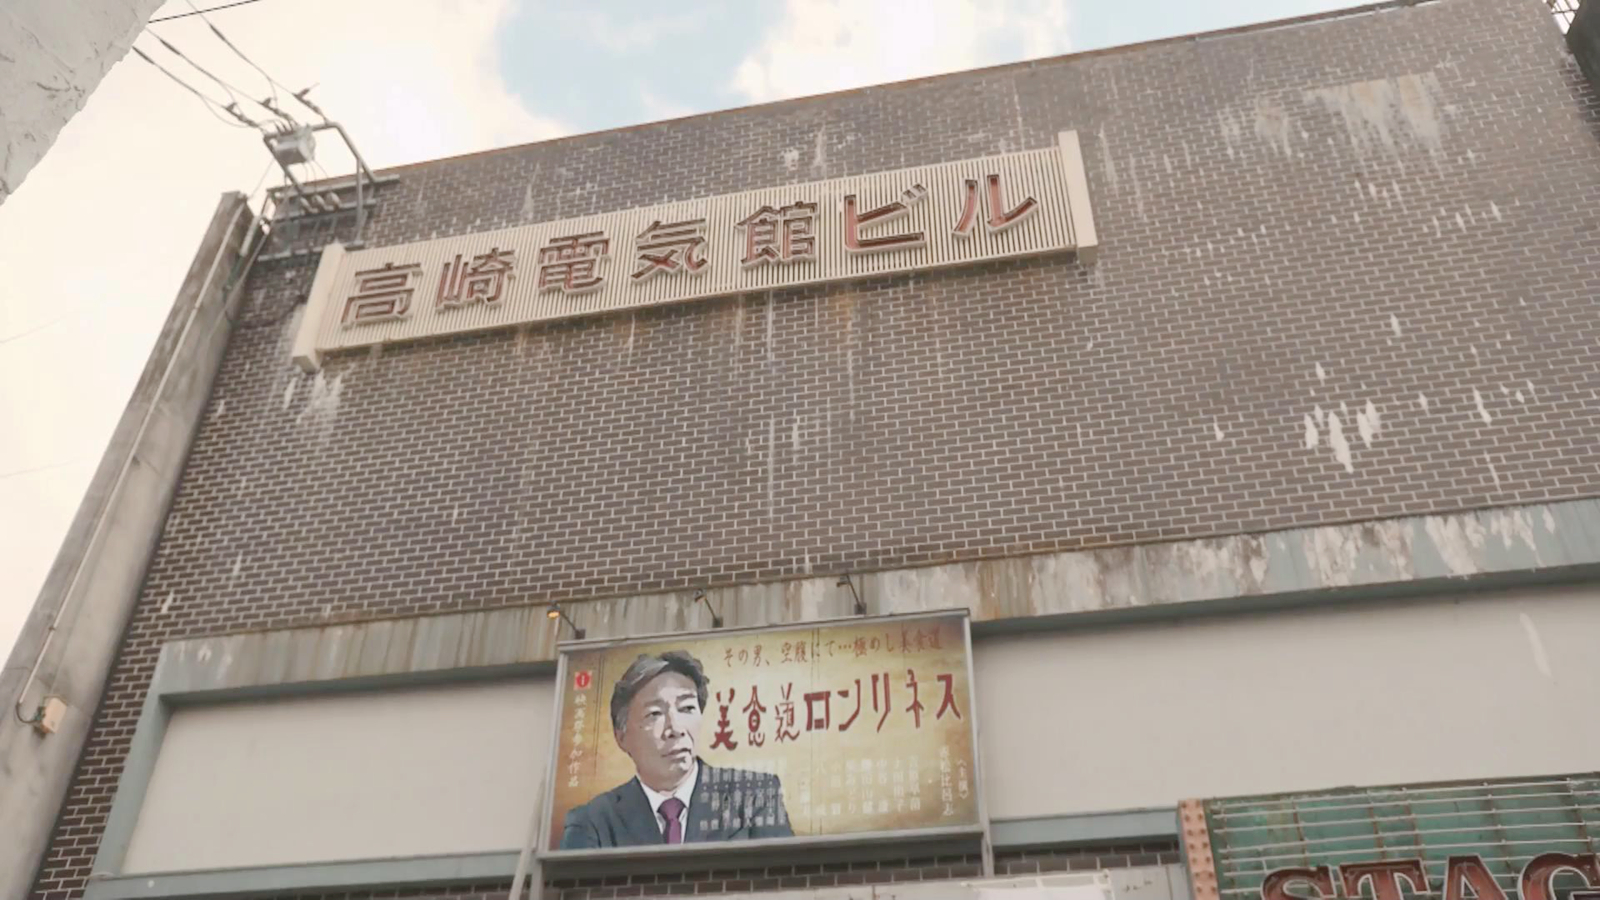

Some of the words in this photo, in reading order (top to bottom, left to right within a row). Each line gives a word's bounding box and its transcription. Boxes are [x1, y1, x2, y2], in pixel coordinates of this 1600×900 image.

[339, 172, 1038, 328] 高崎電気館ビル
[708, 668, 963, 751] 美食道ロンリネス
